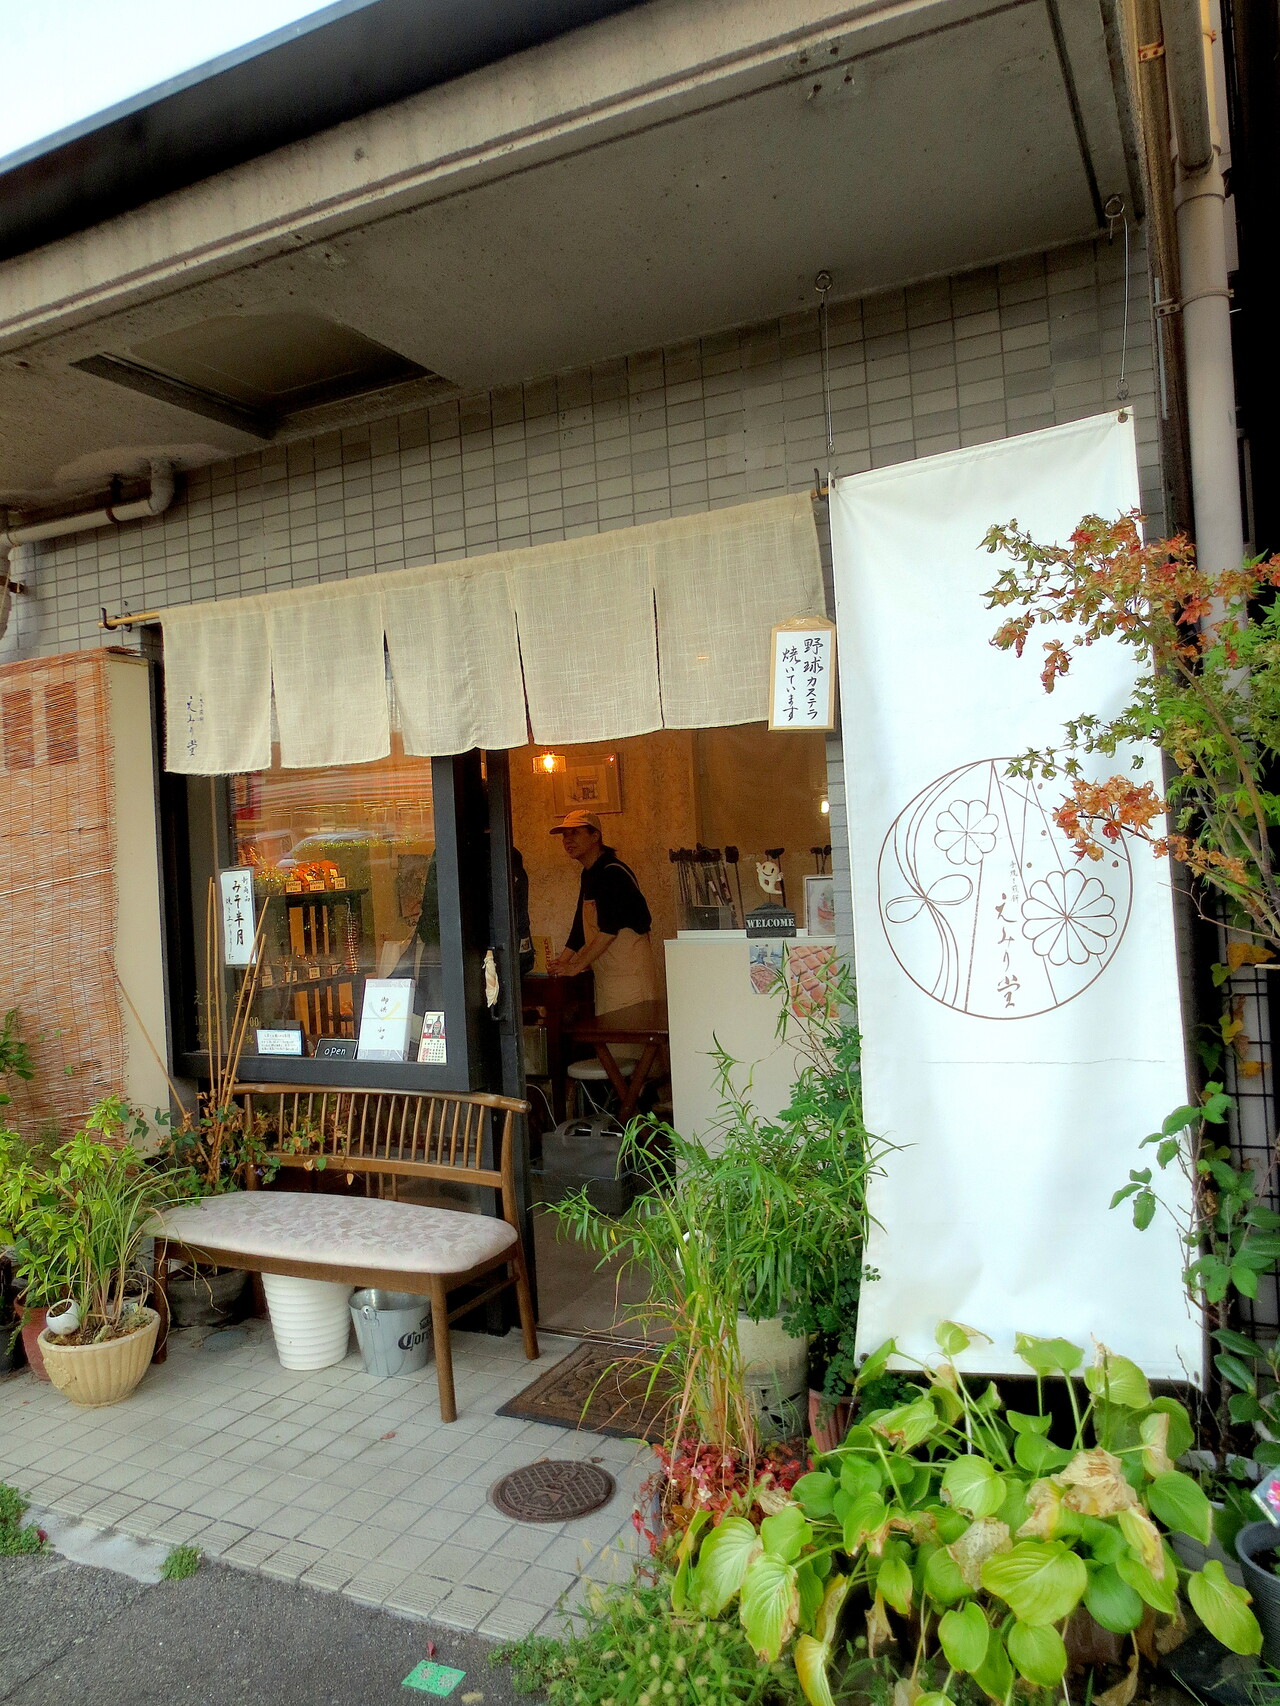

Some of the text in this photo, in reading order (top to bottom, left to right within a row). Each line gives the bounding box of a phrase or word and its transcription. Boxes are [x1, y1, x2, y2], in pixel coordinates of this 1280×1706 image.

[782, 645, 801, 722] 焼いています
[803, 637, 824, 720] 野球カステラ
[746, 917, 795, 928] WELCOME
[995, 892, 1021, 1009] えみり堂
